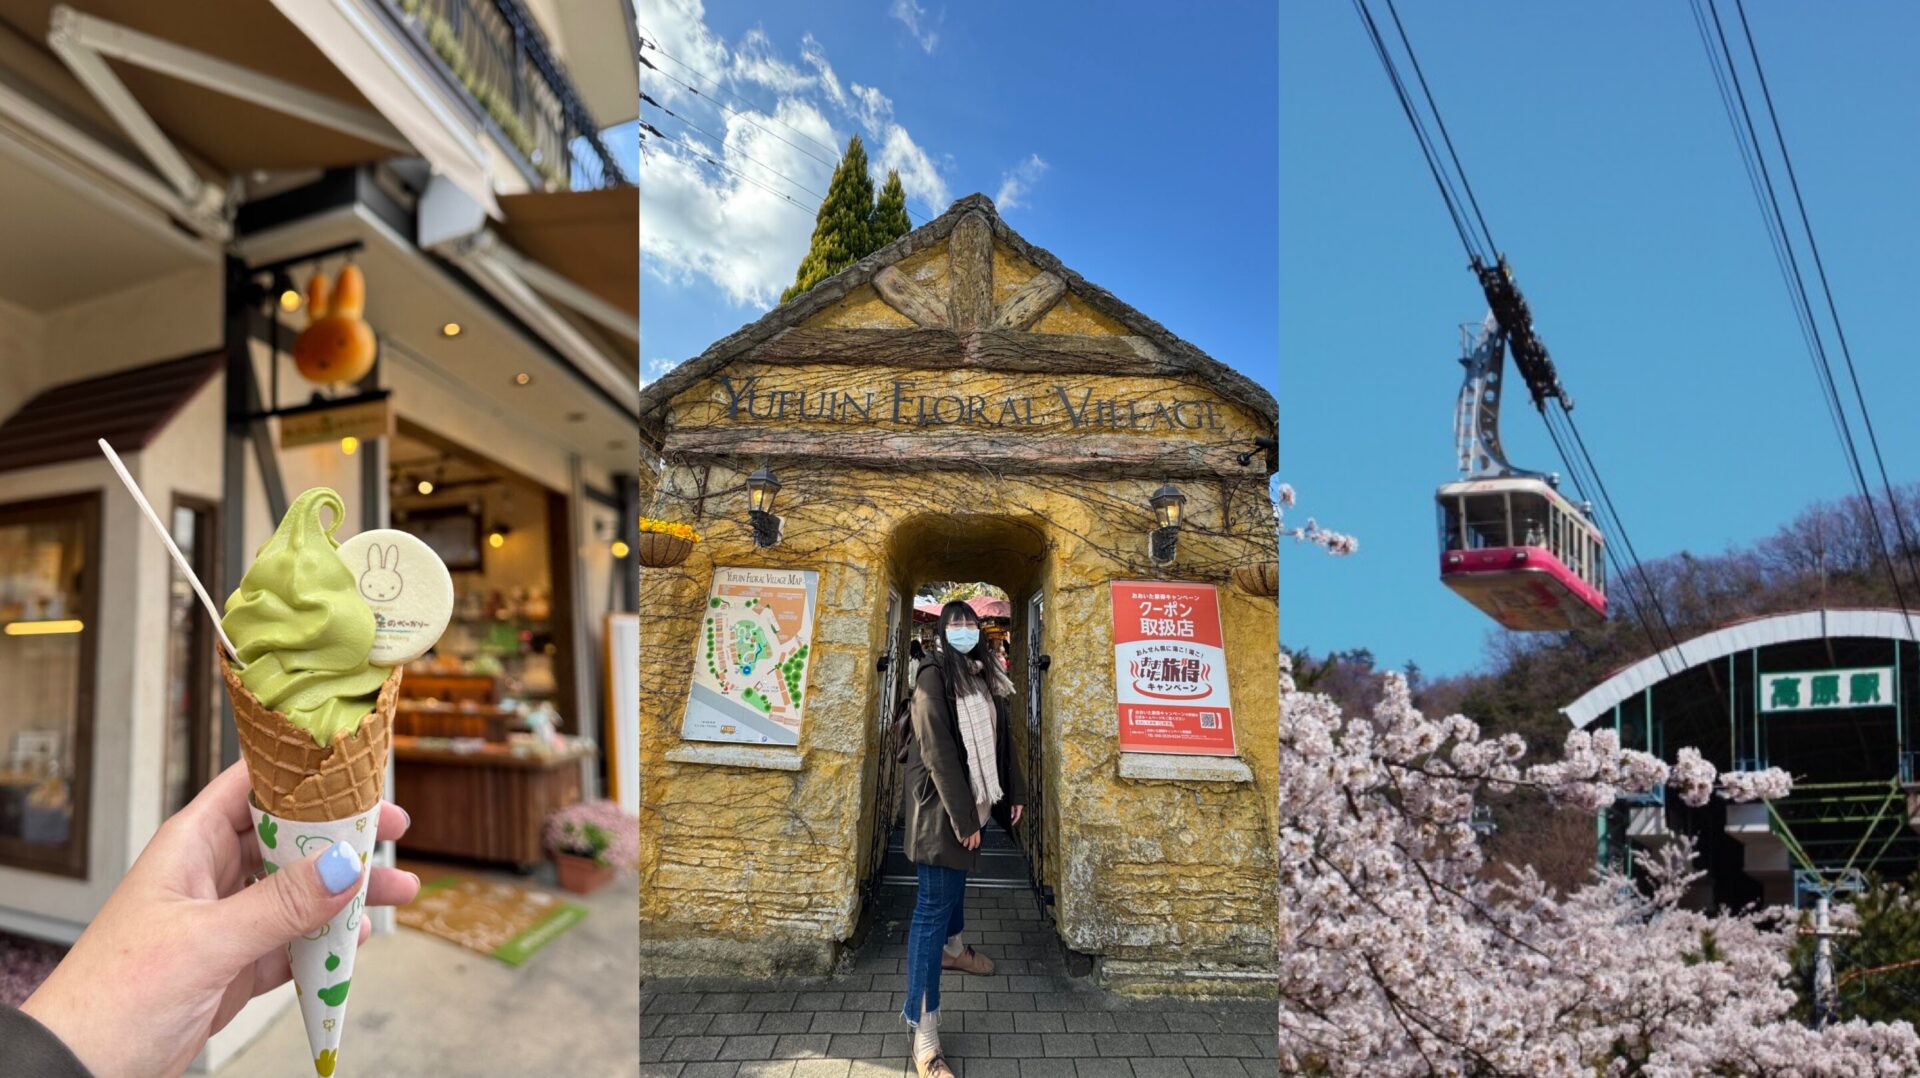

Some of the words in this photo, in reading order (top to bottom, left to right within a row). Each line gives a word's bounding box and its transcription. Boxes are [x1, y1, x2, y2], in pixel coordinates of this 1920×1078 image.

[720, 374, 875, 422] YUFUIN
[891, 379, 1043, 426] FLORAL
[1053, 384, 1226, 430] VILLAGE
[1139, 601, 1192, 617] クーポン
[1140, 618, 1194, 637] 取扱店
[1147, 683, 1198, 692] キャンペーン
[1770, 672, 1881, 708] 高原駅
